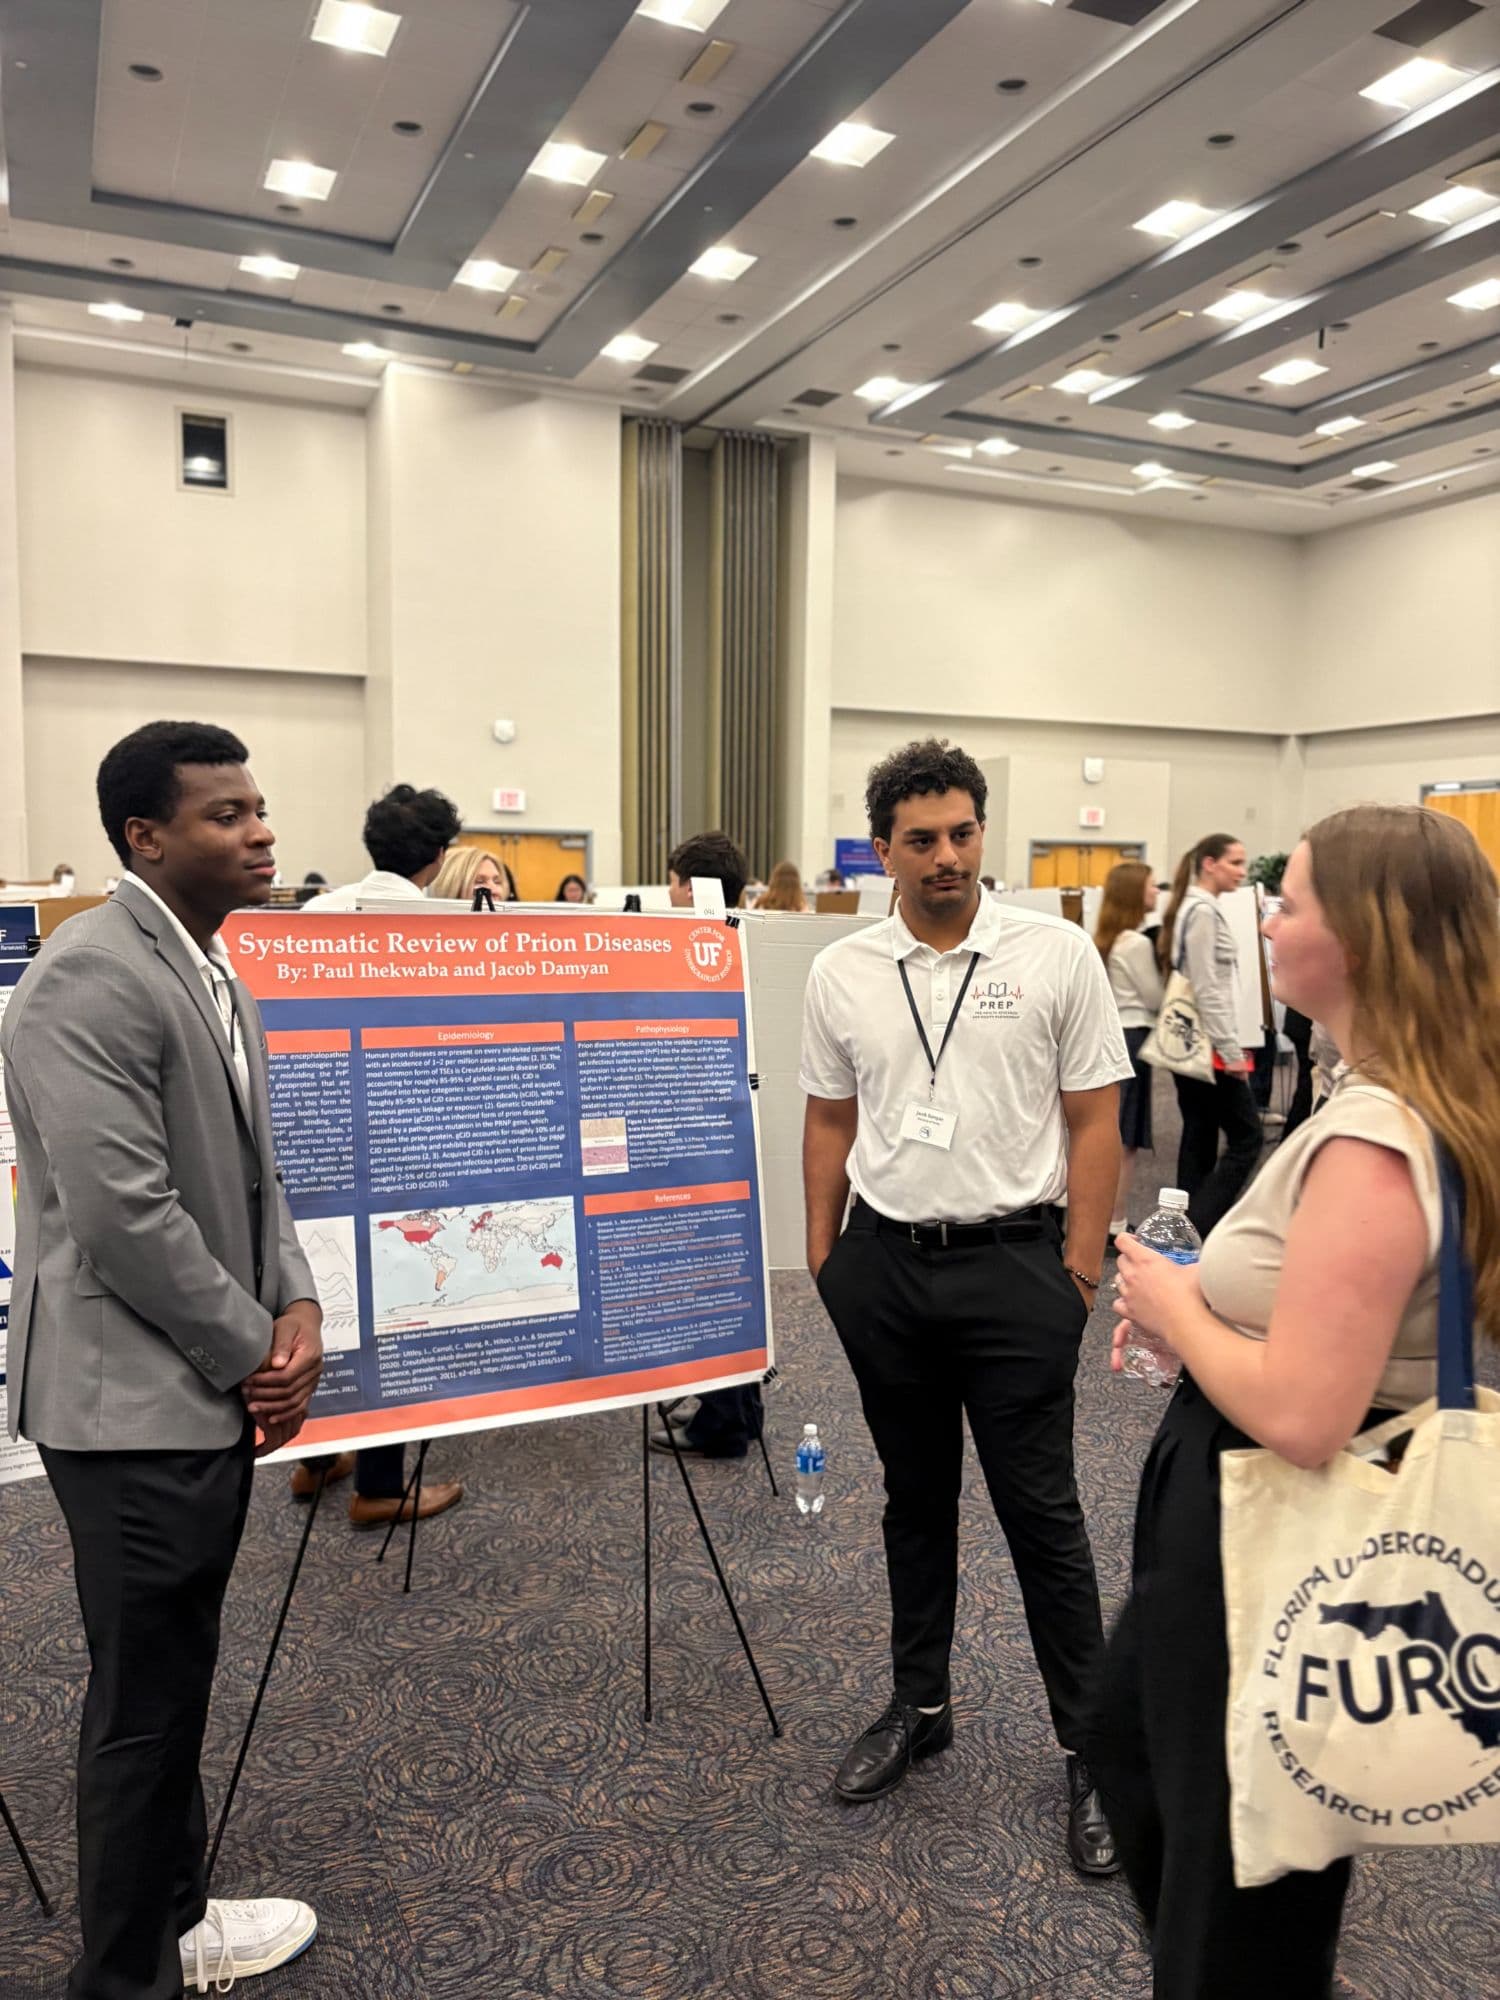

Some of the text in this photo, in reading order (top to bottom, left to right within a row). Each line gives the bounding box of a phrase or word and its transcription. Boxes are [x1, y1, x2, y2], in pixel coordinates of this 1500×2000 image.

[239, 932, 379, 960] Systematic
[387, 932, 477, 953] Review
[486, 932, 509, 953] of
[516, 932, 578, 952] Prion
[584, 932, 672, 952] Diseases
[693, 942, 722, 966] UF
[277, 961, 609, 983] By: Paul Ihekwaba and Jacob Damyan
[980, 1001, 1013, 1009] PREP
[636, 1025, 690, 1033] Pathophysiology
[438, 1030, 494, 1041] Epidemiology
[290, 1052, 348, 1061] encephalopathies
[391, 1051, 408, 1059] prion
[449, 1048, 472, 1057] present
[294, 1062, 332, 1070] pathologies
[462, 1065, 514, 1074] Creutzfeldt-Jakob
[275, 1082, 317, 1090] glycoprotein
[414, 1078, 438, 1086] roughly
[473, 1075, 492, 1083] global
[431, 1086, 464, 1094] categories:
[535, 1080, 560, 1089] acquired
[368, 1108, 396, 1117] previous
[398, 1106, 421, 1115] genetic
[371, 1184, 404, 1192] iatrogenic
[655, 1193, 691, 1203] References
[1263, 1710, 1392, 1826] RESEARCH
